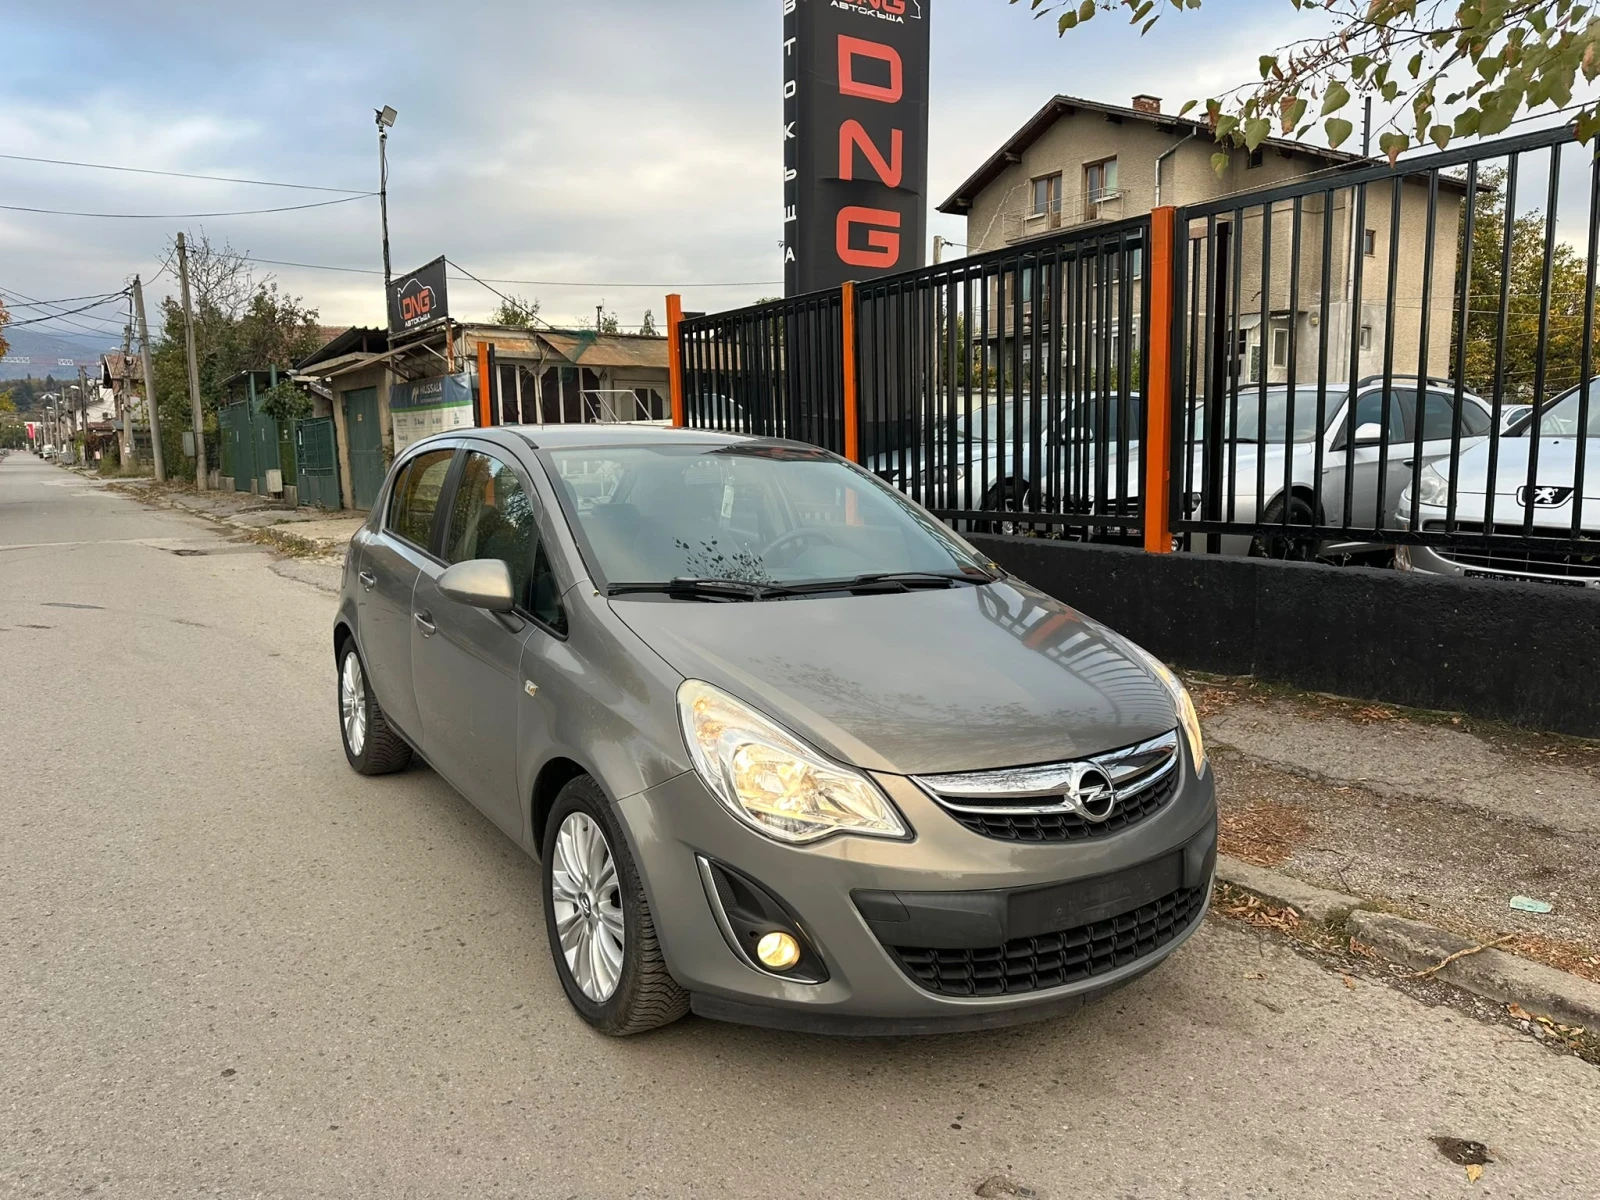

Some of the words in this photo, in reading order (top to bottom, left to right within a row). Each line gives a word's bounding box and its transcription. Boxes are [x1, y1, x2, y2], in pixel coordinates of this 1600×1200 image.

[830, 0, 904, 24] АВТОКЪША
[836, 33, 903, 269] DNG
[402, 288, 430, 320] DNG
